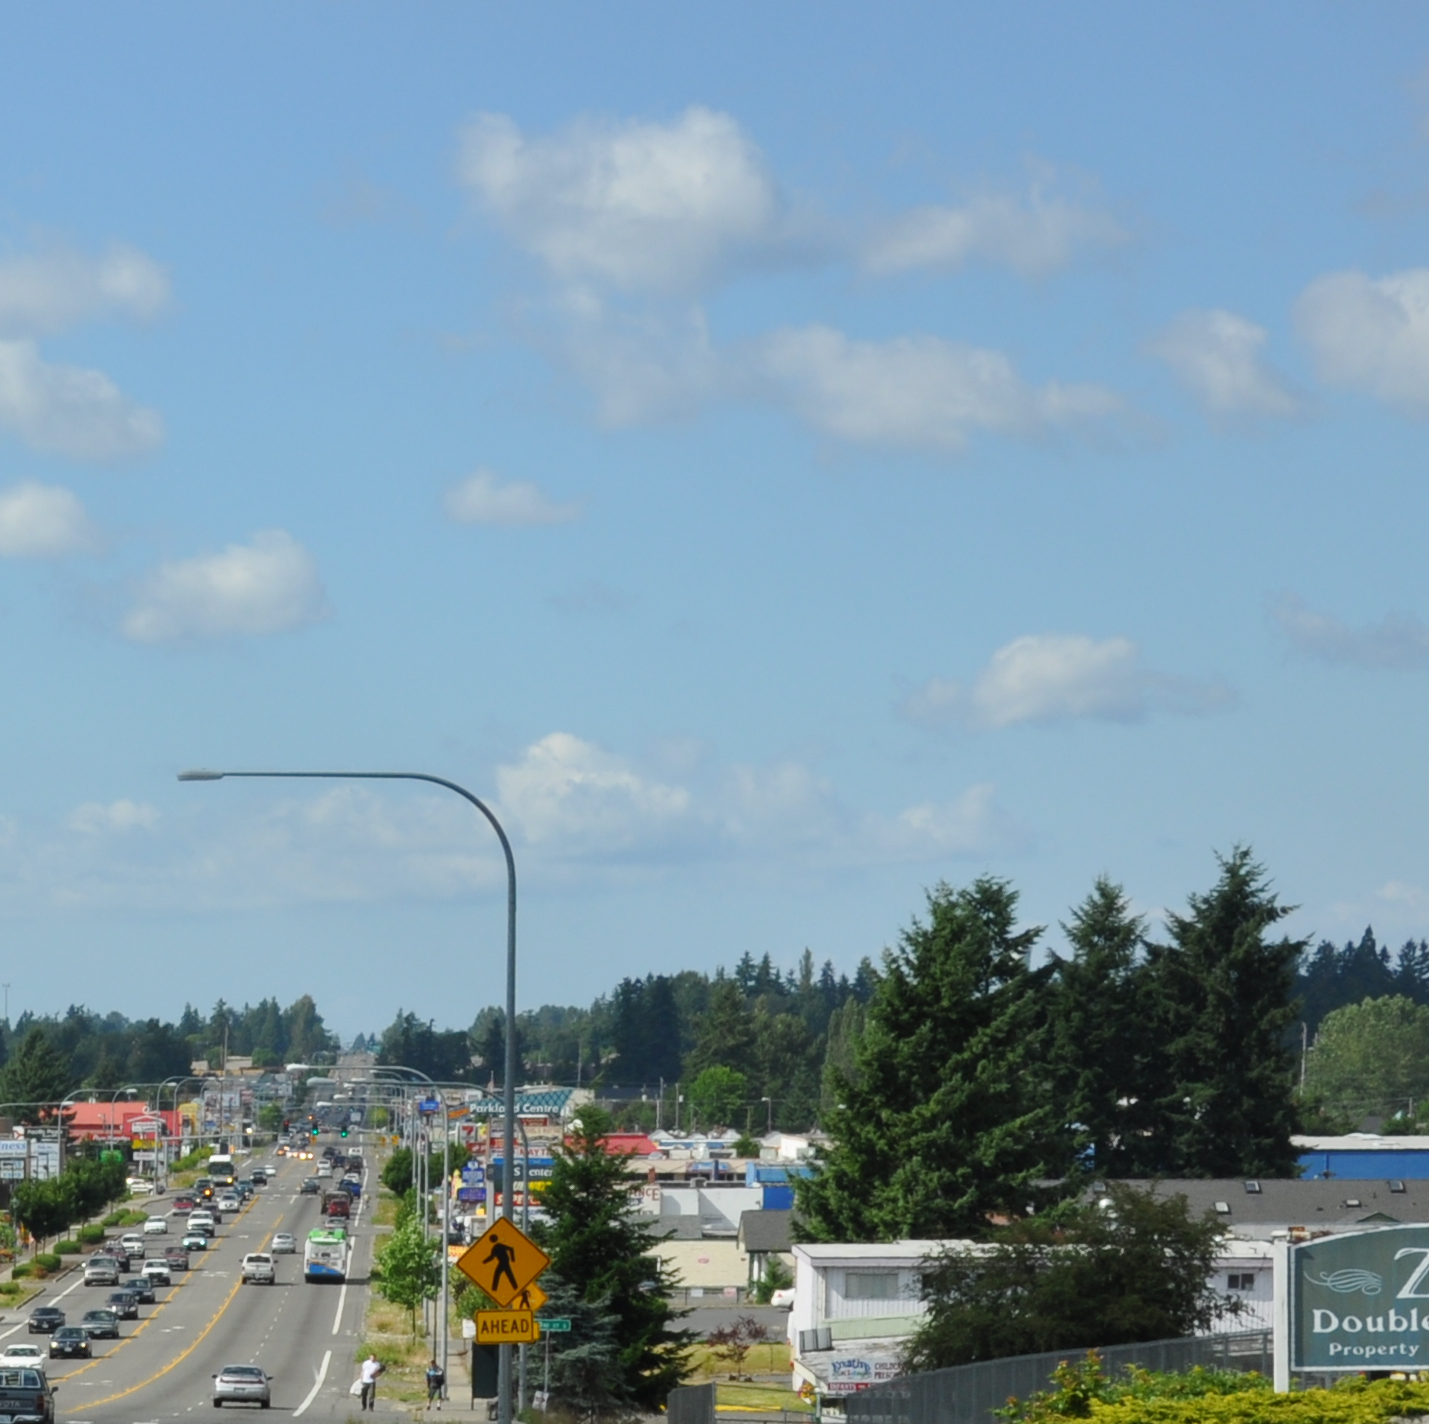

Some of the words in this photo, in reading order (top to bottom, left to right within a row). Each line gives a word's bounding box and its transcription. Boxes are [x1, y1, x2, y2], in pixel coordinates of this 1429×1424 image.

[469, 1103, 520, 1113] Parklad
[522, 1103, 559, 1113] Centre
[480, 1318, 530, 1335] AHEAD
[1328, 1342, 1420, 1358] Property
